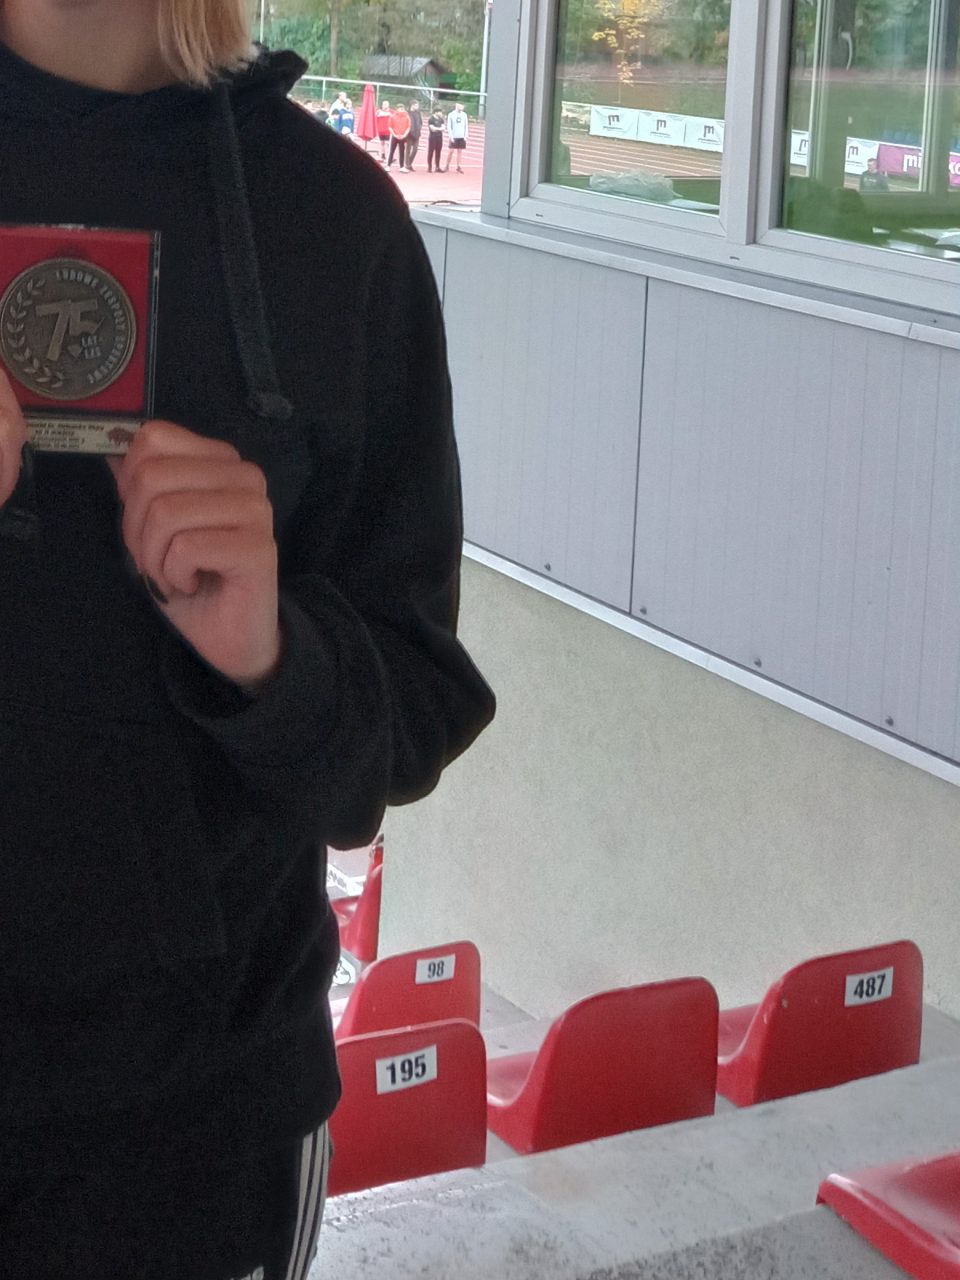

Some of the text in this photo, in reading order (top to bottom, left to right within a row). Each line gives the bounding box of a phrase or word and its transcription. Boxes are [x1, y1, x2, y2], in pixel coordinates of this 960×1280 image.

[427, 959, 445, 979] 98
[853, 972, 887, 999] 487
[385, 1053, 428, 1086] 195
